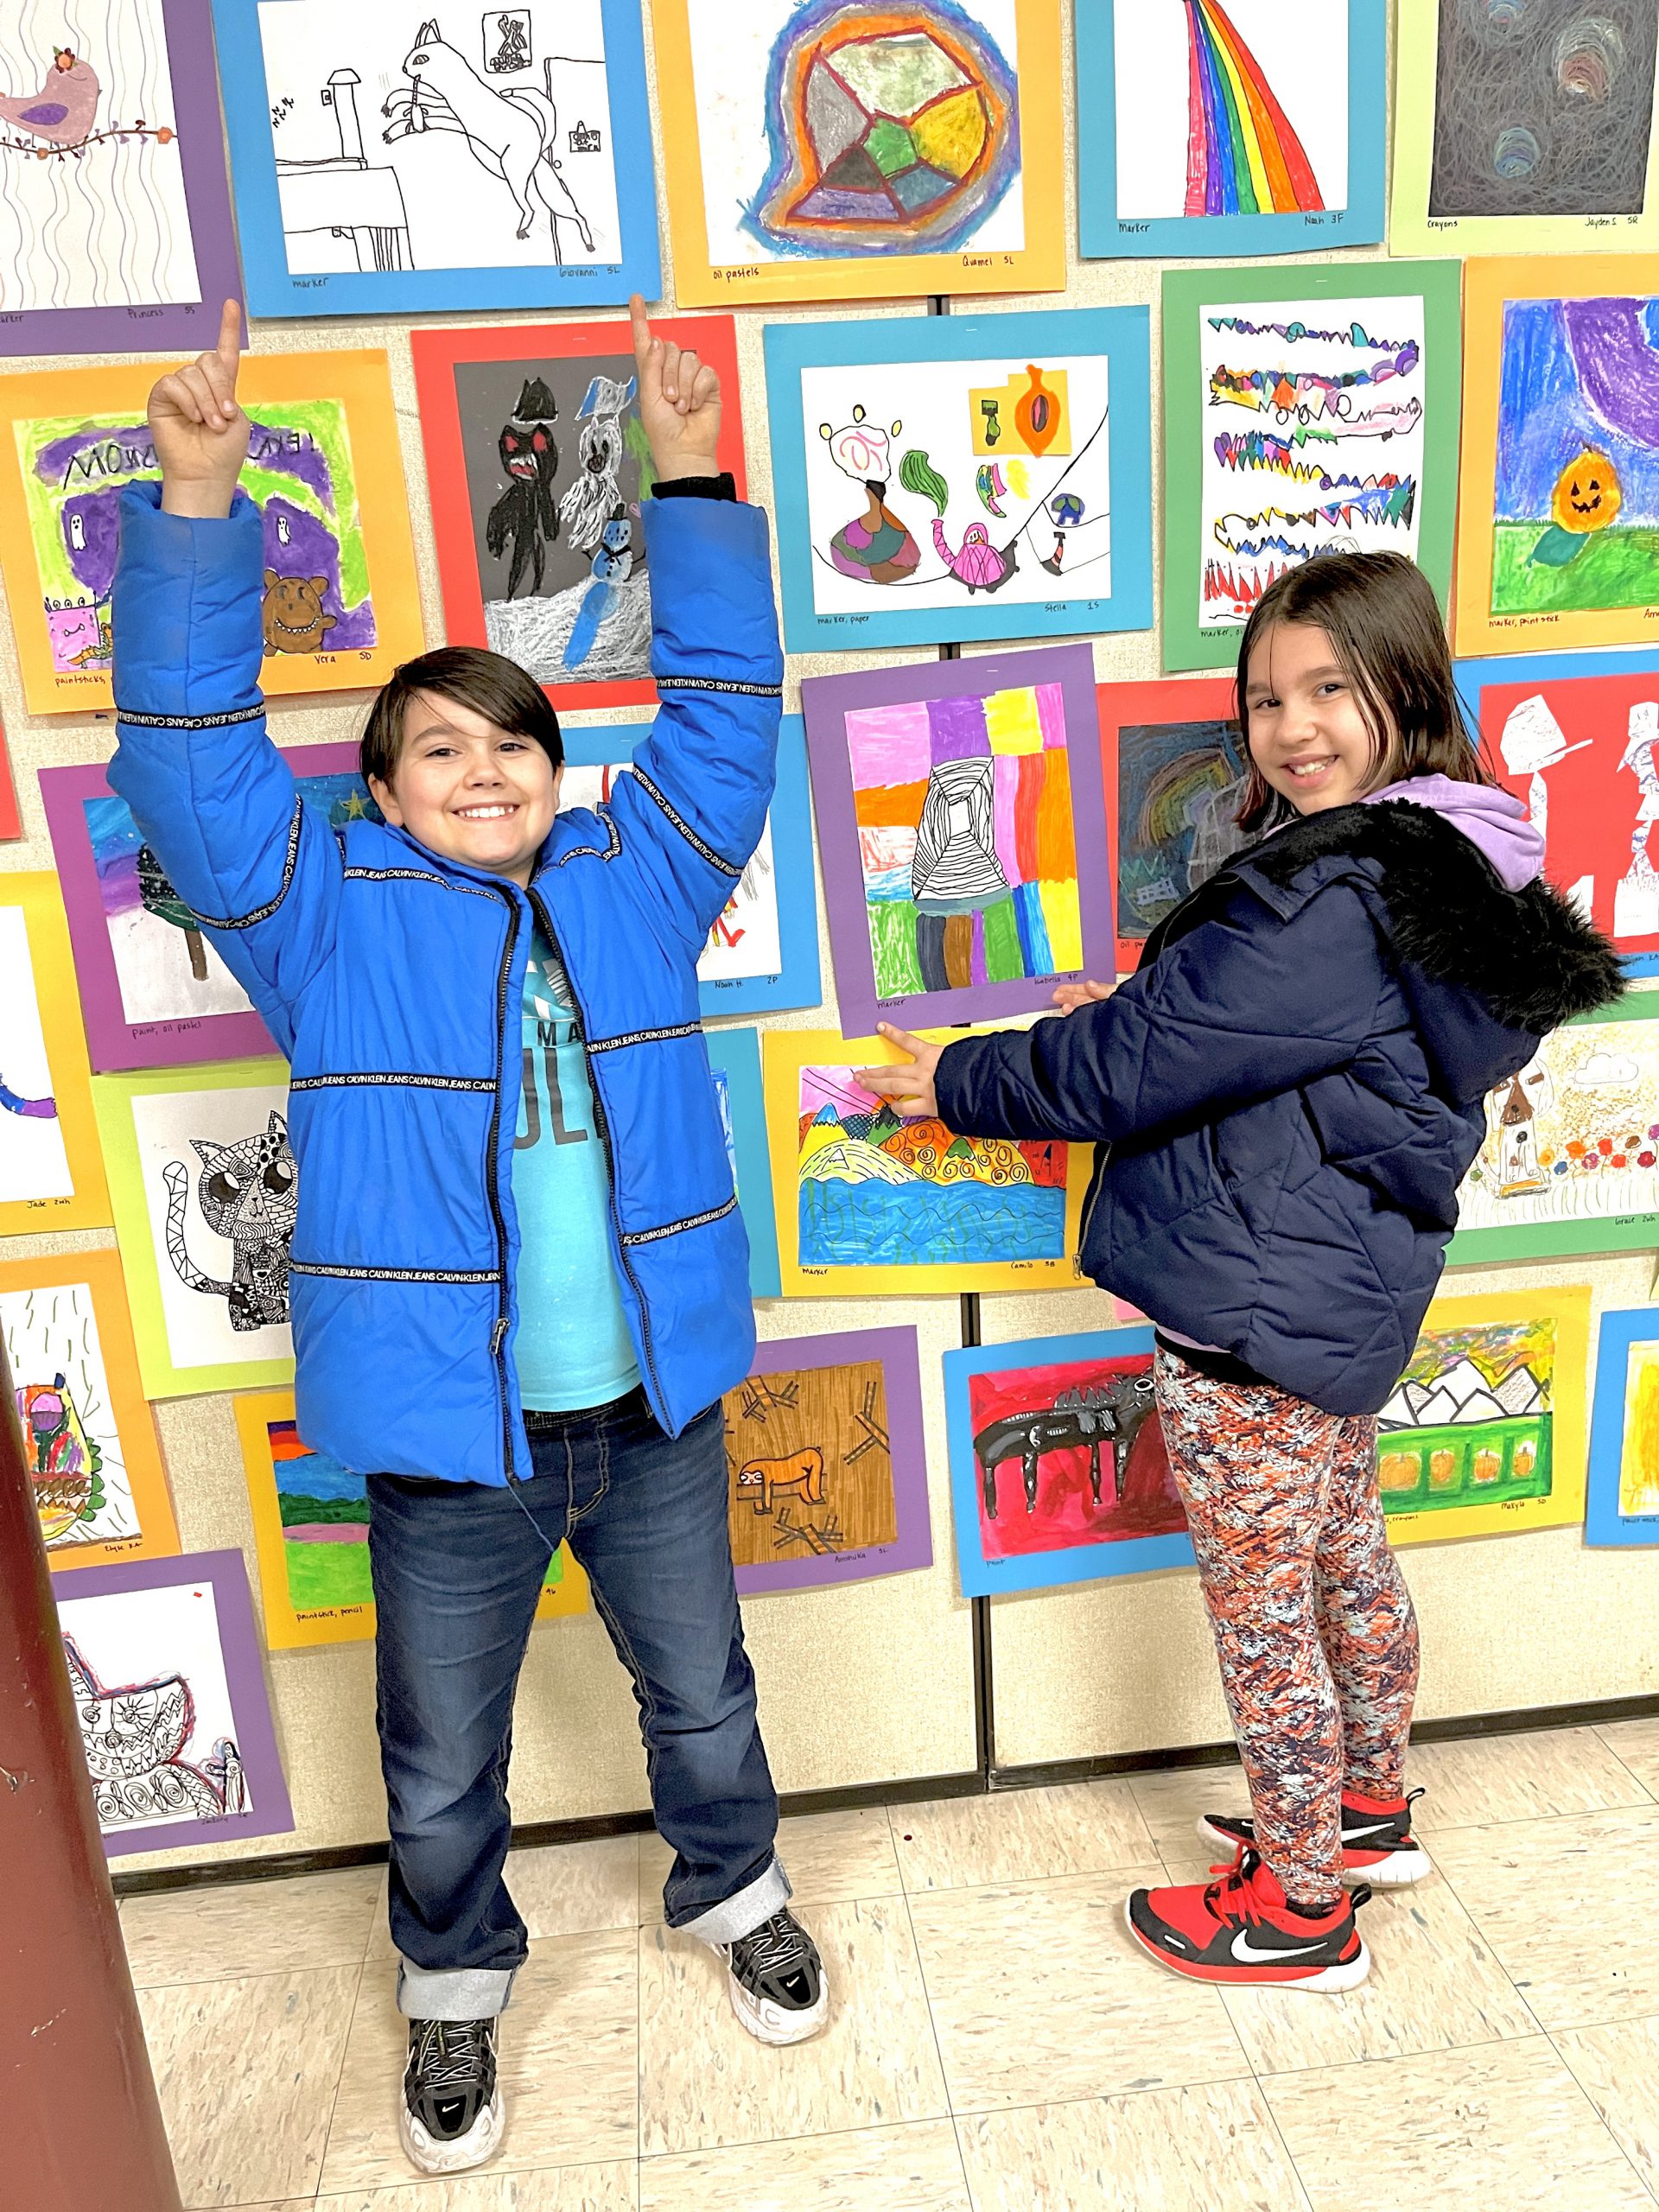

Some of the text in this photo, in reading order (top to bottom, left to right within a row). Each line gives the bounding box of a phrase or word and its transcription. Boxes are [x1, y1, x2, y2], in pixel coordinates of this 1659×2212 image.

[726, 267, 760, 283] pastels
[0, 314, 24, 324] arker
[127, 308, 164, 319] Princess
[716, 682, 739, 692] JEANS
[203, 715, 228, 726] JEANS
[177, 1020, 202, 1033] pastel
[386, 1075, 409, 1084] JEANS
[448, 1079, 472, 1089] JEANS
[27, 1200, 47, 1209] Jade
[347, 1268, 367, 1278] JEANS
[412, 1271, 435, 1281] JEANS
